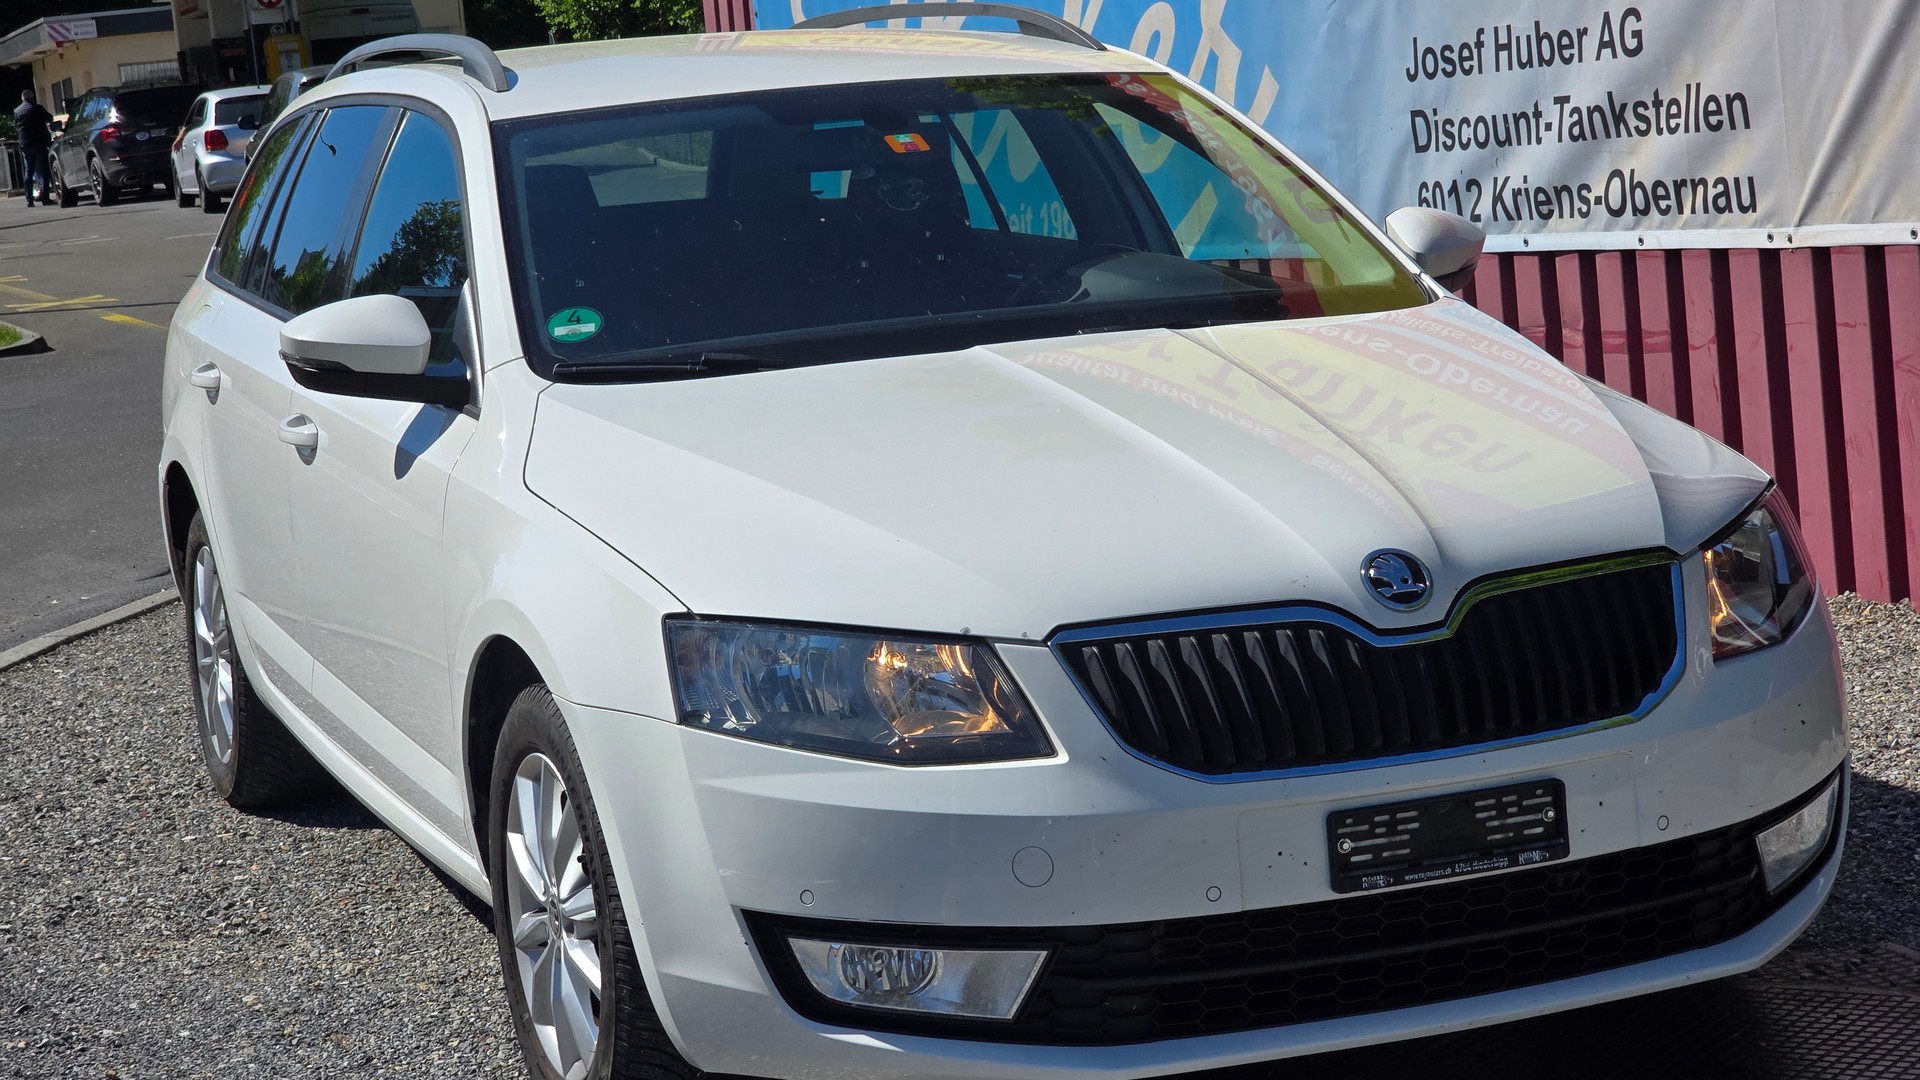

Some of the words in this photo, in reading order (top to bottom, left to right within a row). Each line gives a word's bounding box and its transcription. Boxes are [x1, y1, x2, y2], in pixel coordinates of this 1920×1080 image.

[1406, 28, 1484, 82] Josef
[1493, 20, 1588, 72] Huber
[1595, 7, 1644, 61] AG
[1410, 82, 1751, 153] Discount-Tankstellen
[1000, 203, 1033, 235] eit
[1417, 178, 1483, 223] 6012
[1491, 168, 1758, 222] Kriens-Obernau
[566, 309, 583, 324] 4
